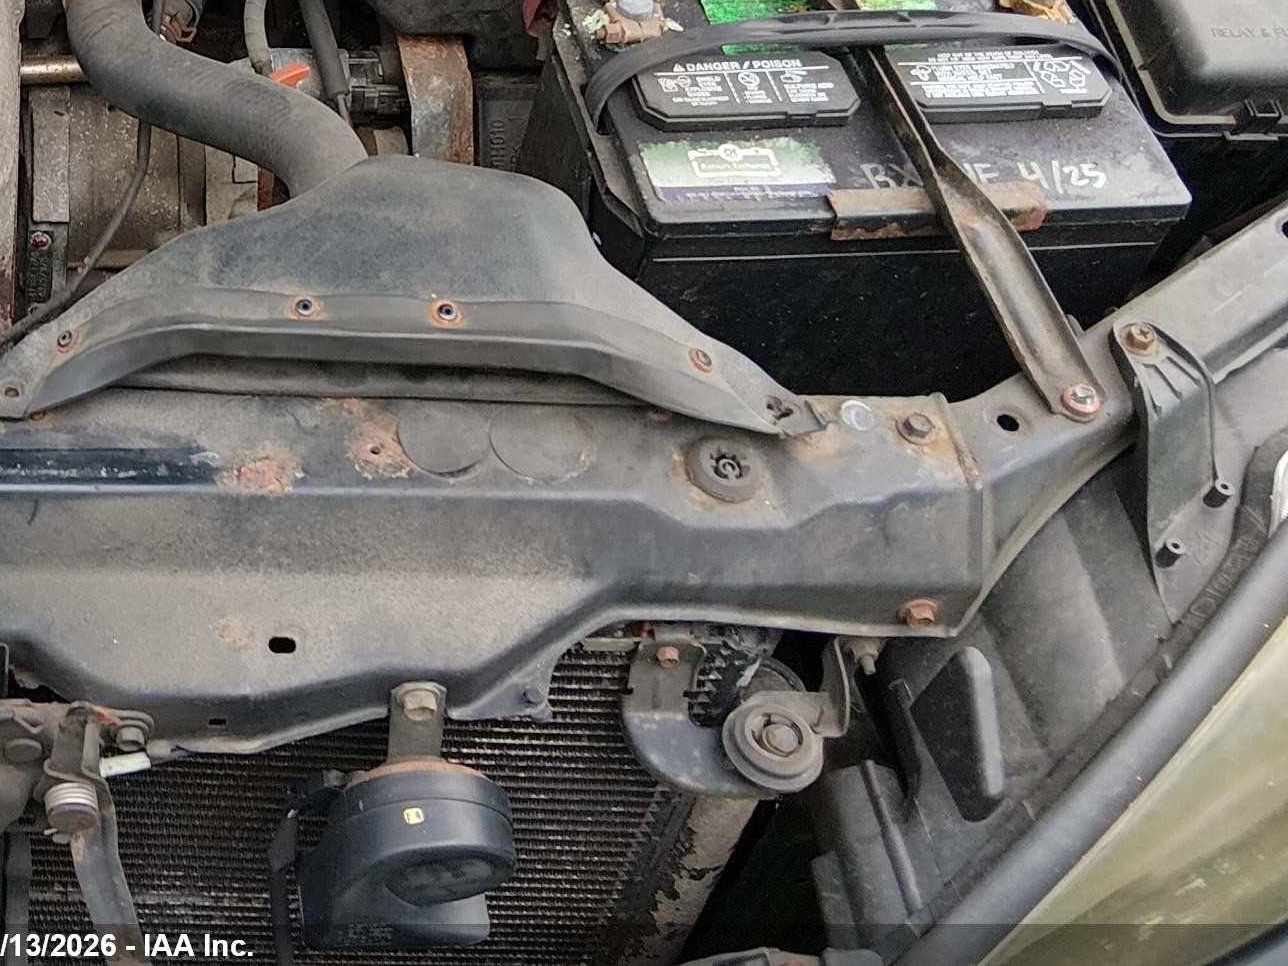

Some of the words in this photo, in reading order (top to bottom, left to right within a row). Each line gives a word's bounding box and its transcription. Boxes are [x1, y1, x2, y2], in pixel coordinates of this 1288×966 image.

[686, 61, 740, 72] DANGER
[753, 59, 802, 69] POISON
[1016, 160, 1108, 195] 4/25
